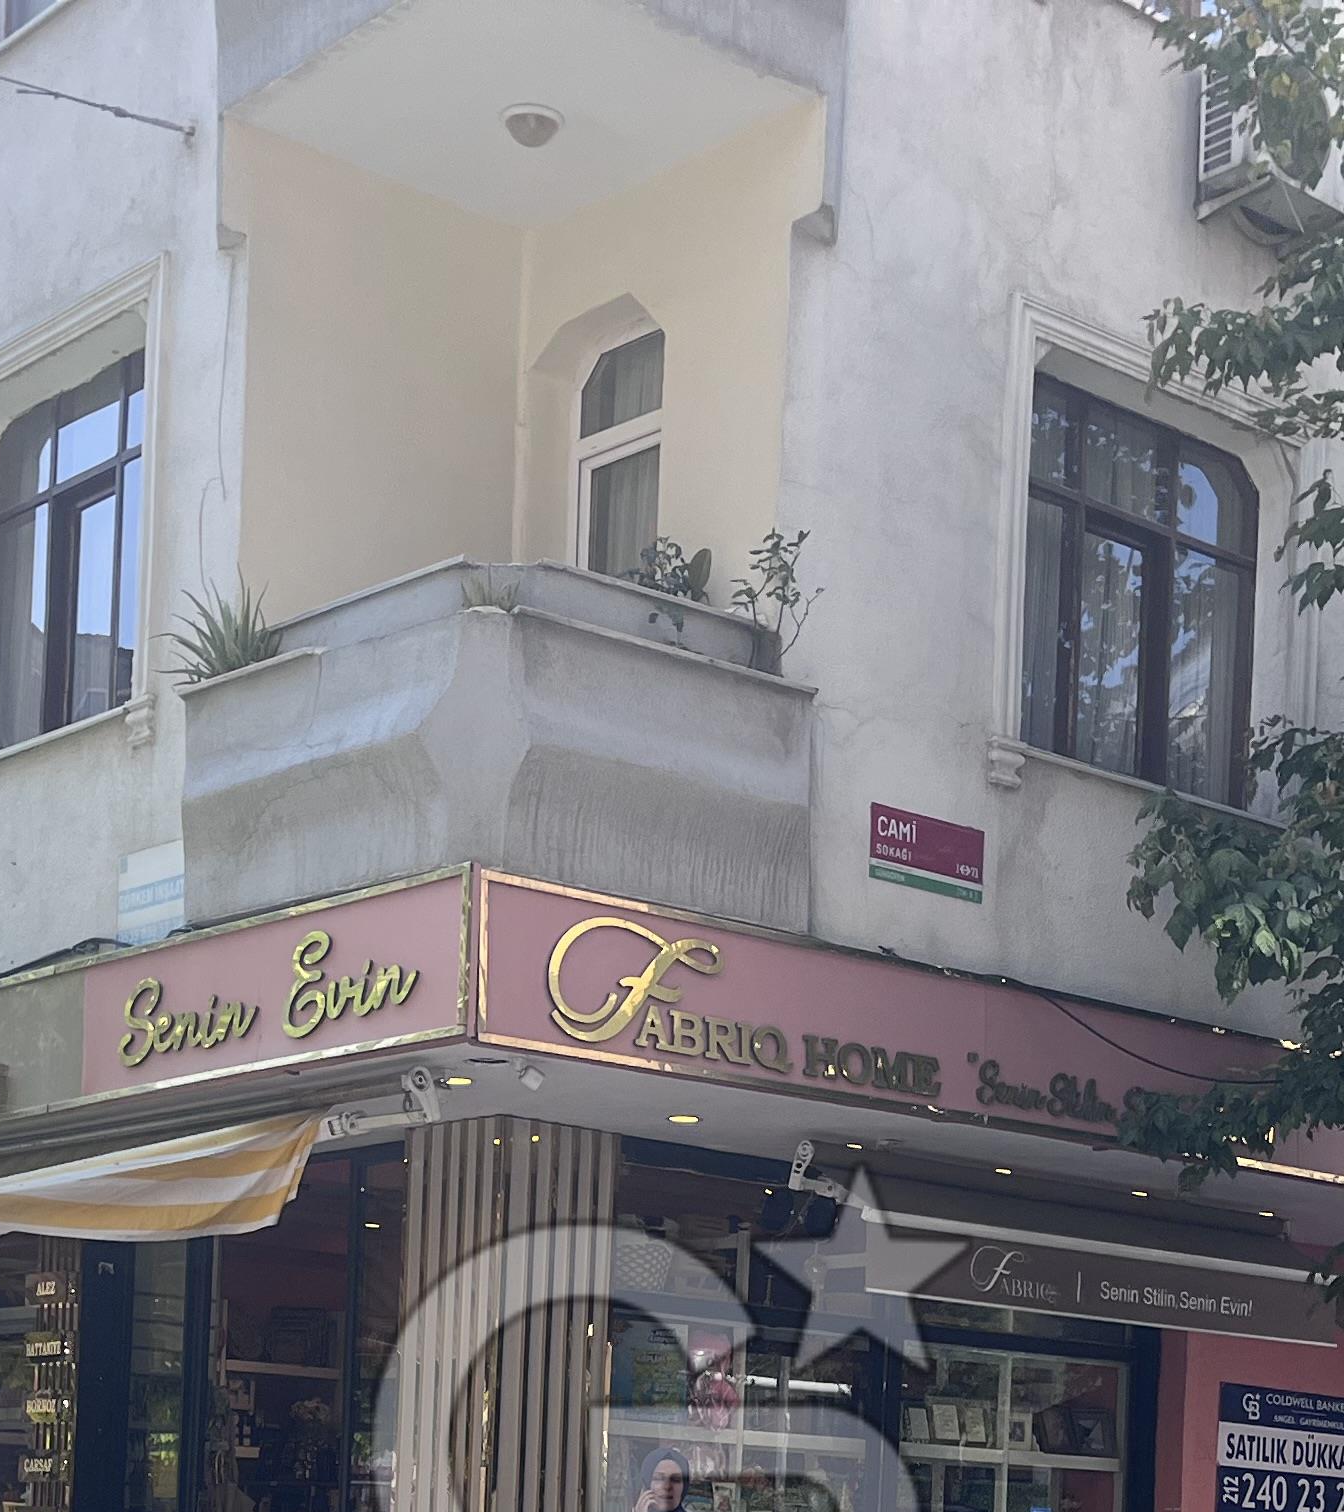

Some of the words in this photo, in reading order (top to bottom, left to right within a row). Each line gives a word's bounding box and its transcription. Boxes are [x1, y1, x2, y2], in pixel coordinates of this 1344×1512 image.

[877, 815, 917, 844] CAMİ
[119, 976, 258, 1067] Senin
[282, 930, 421, 1039] Evin
[802, 1033, 942, 1097] HOME
[1100, 1280, 1139, 1304] Senin
[1220, 1296, 1254, 1318] Evin!
[1265, 1393, 1315, 1410] COLDWELL
[1225, 1432, 1288, 1465] SATILIK
[1222, 1475, 1239, 1504] 212
[1241, 1472, 1288, 1512] 240
